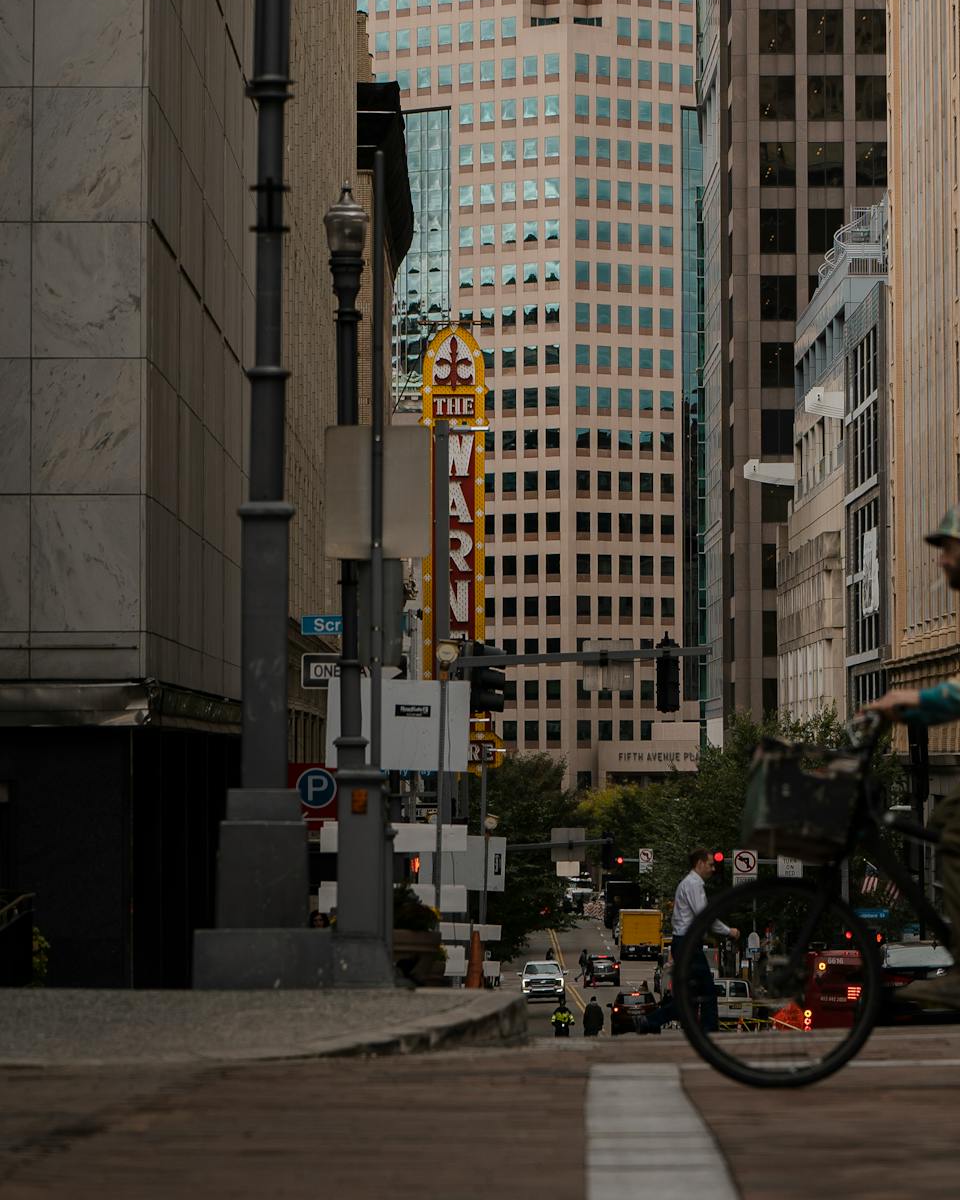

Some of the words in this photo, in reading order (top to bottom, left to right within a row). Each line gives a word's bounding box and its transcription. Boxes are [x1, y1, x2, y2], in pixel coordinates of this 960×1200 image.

[434, 397, 474, 416] THE
[618, 752, 644, 761] FIFTH
[646, 752, 681, 761] AVENUE
[307, 775, 328, 801] P
